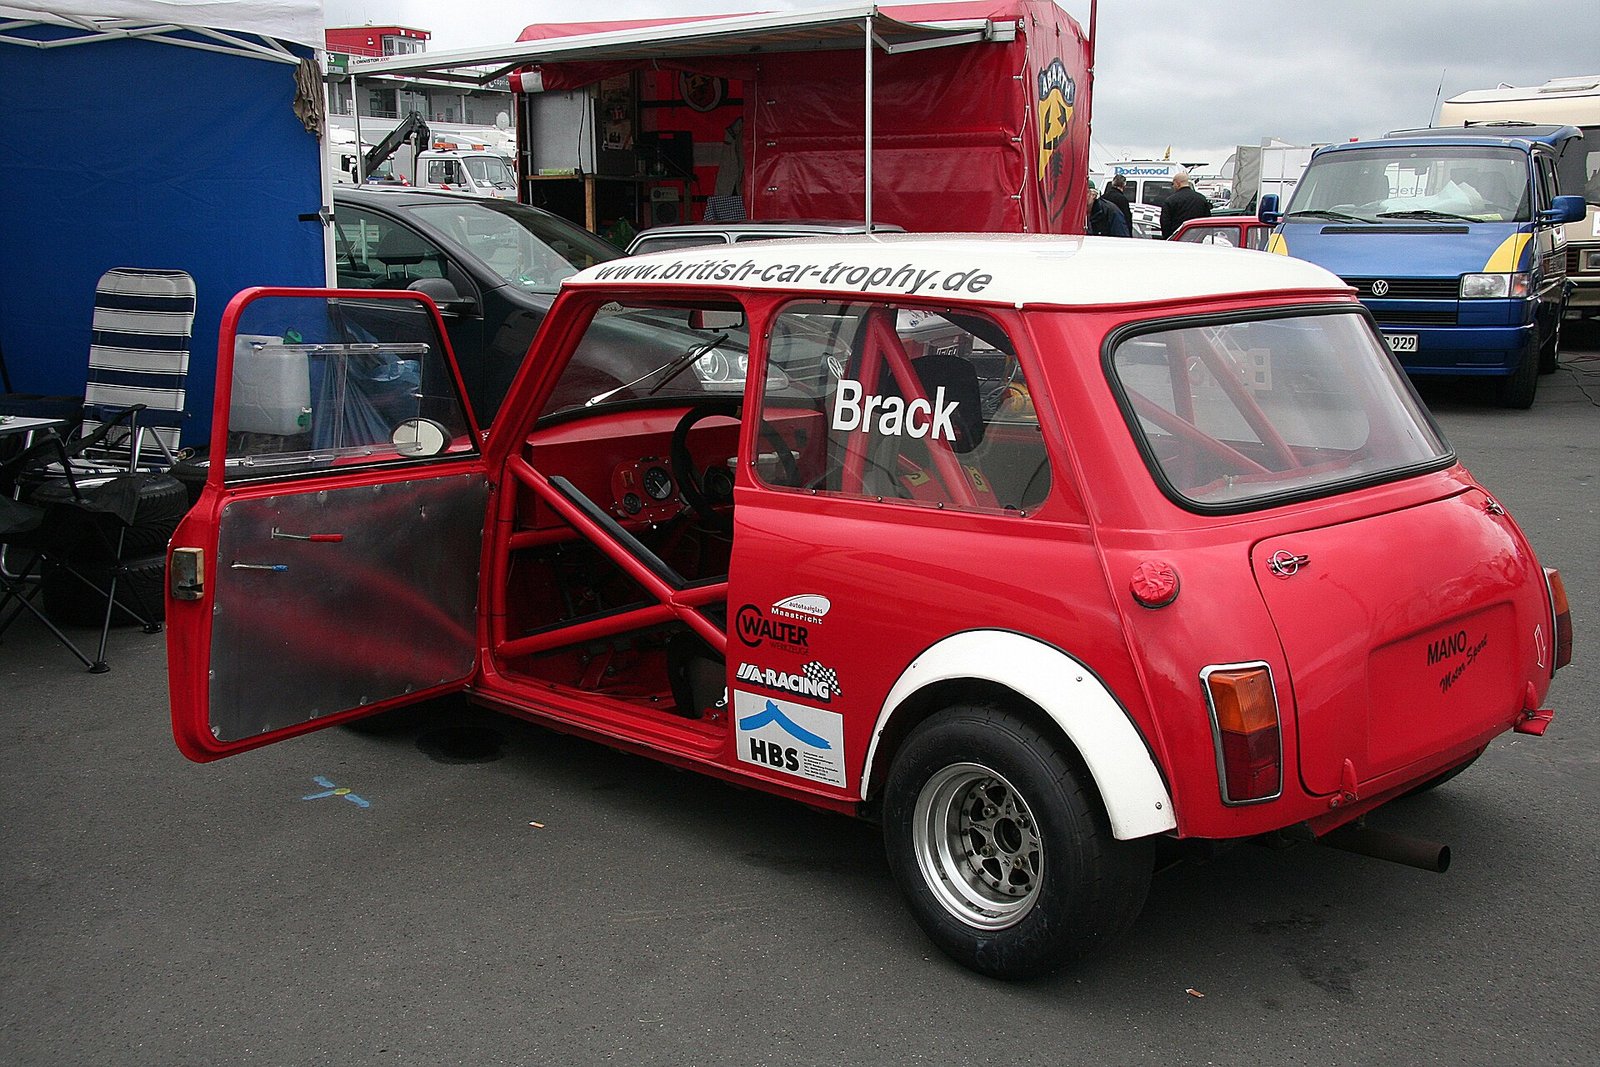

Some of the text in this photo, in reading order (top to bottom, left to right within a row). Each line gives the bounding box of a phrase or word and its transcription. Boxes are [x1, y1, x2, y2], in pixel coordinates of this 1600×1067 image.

[1043, 63, 1071, 100] ABARTH
[1114, 166, 1170, 175] Rockwood
[595, 259, 992, 294] www.british-car-trophy.de
[1392, 337, 1415, 350] 929
[832, 379, 960, 442] Brack
[742, 614, 809, 647] WALTER
[771, 607, 823, 624] Maastricht
[1427, 630, 1467, 666] MANO
[749, 737, 800, 772] HBS
